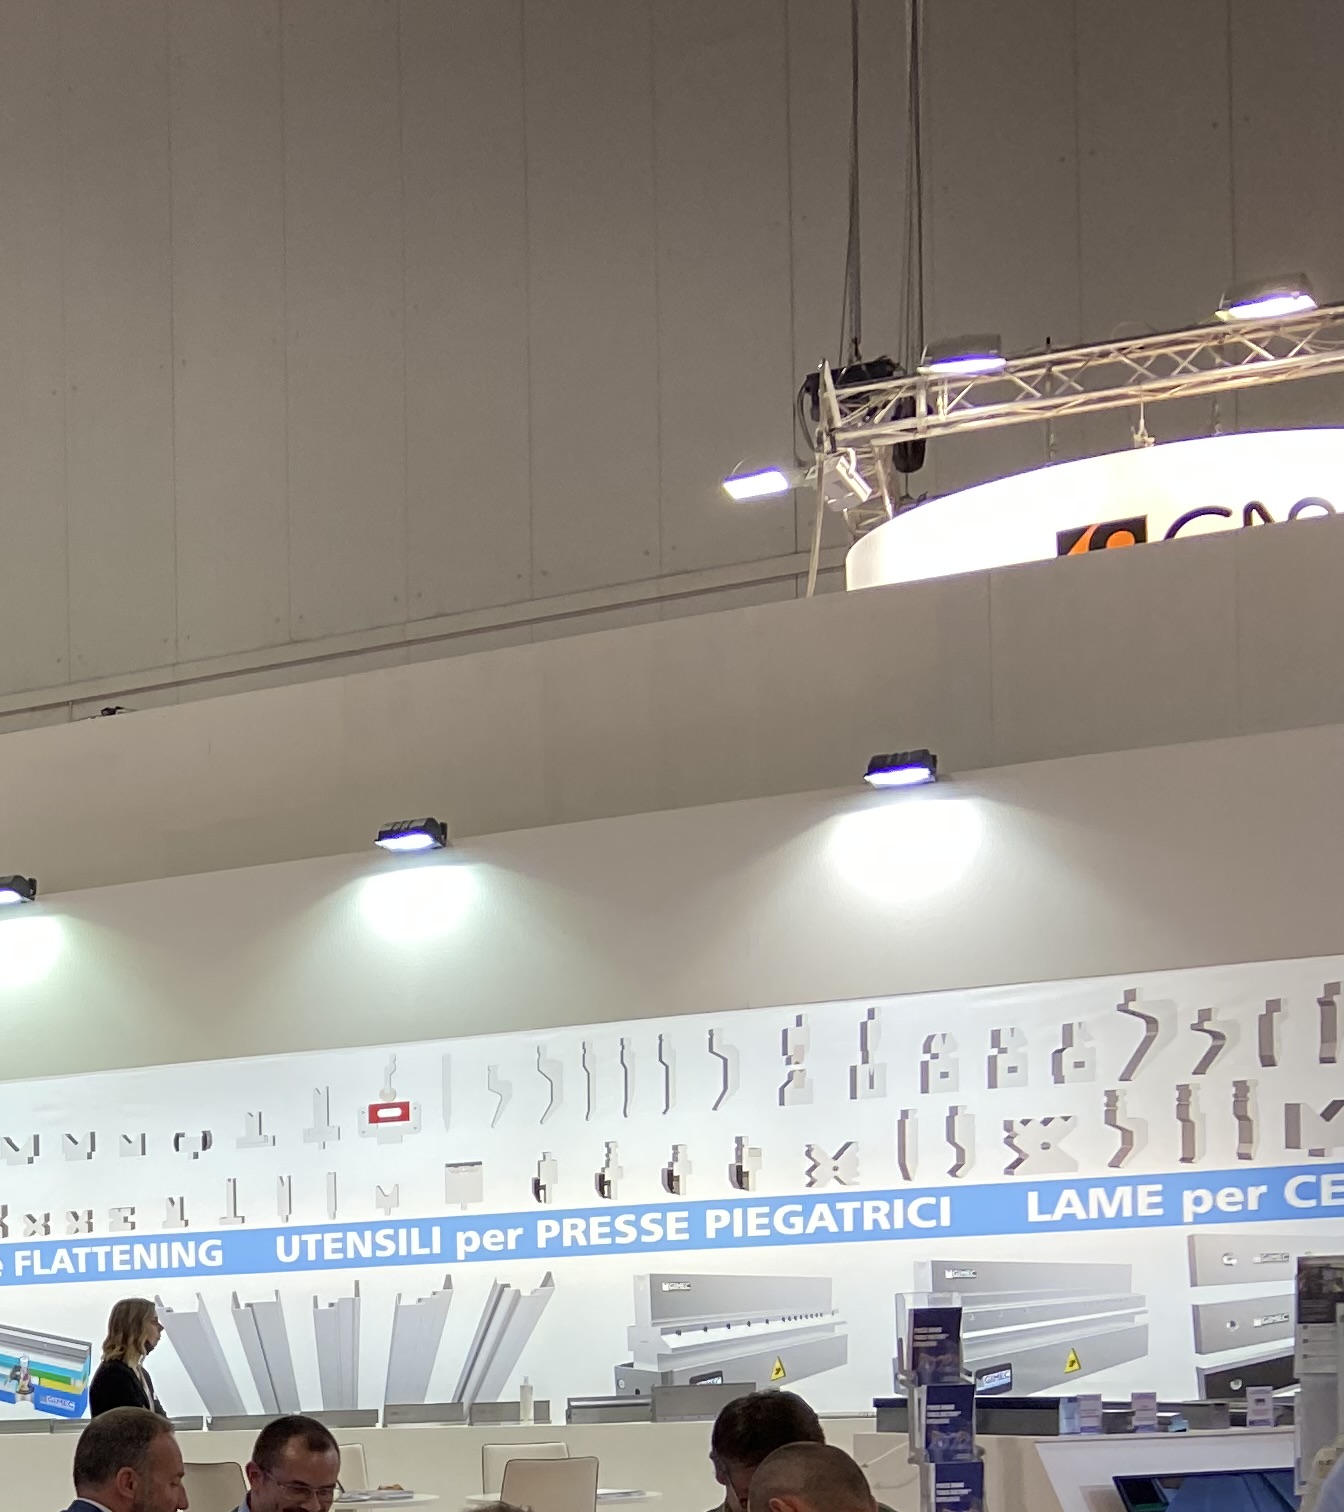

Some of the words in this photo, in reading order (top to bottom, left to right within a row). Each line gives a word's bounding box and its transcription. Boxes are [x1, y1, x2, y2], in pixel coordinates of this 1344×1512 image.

[1027, 1184, 1165, 1223] LAME
[1183, 1185, 1268, 1224] per
[1284, 1173, 1344, 1208] CE
[275, 1225, 441, 1263] UTENSILI
[455, 1227, 524, 1261] per
[536, 1210, 690, 1249] PRESSE
[705, 1196, 951, 1239] PIEGATRICI
[14, 1238, 223, 1277] FLATTENING
